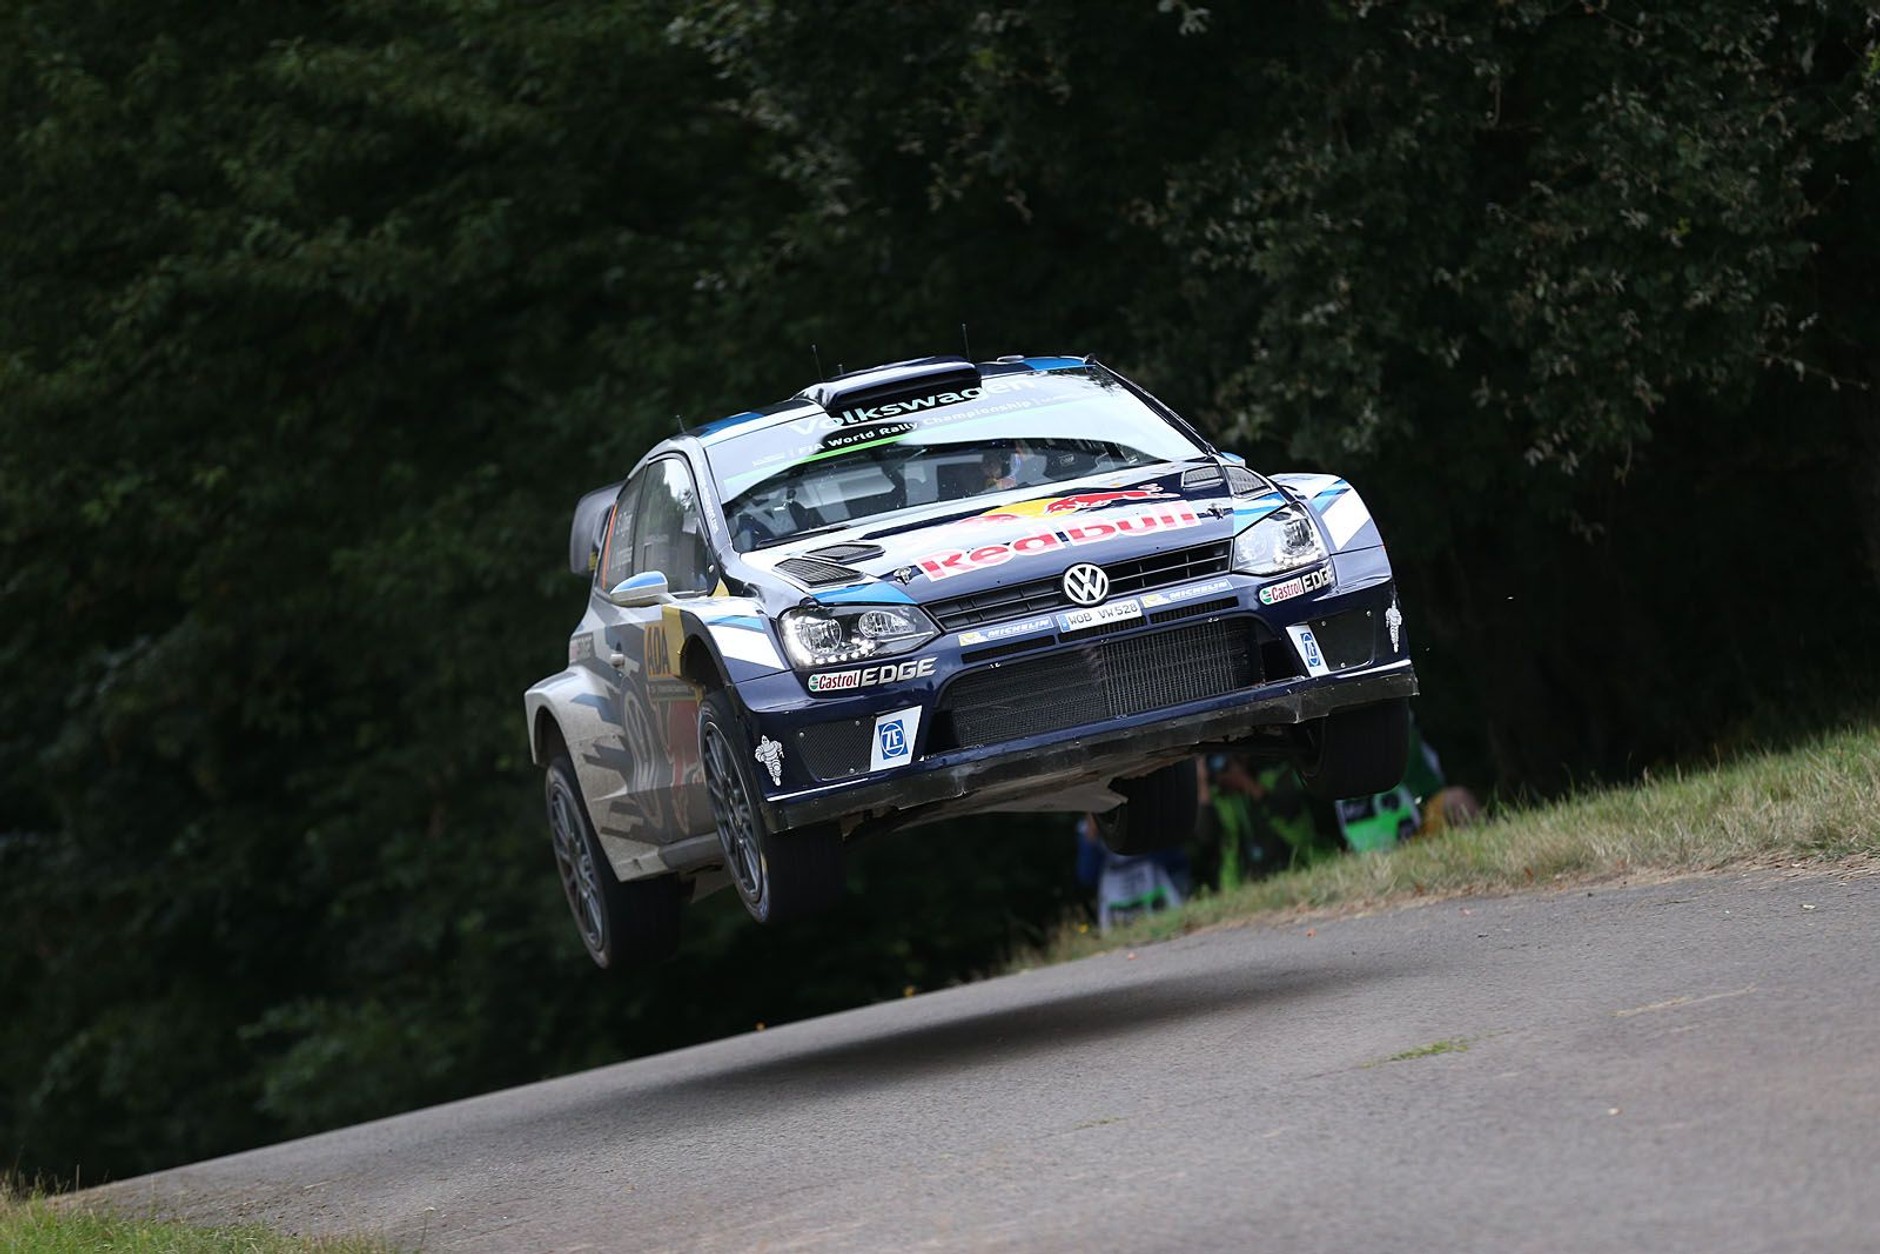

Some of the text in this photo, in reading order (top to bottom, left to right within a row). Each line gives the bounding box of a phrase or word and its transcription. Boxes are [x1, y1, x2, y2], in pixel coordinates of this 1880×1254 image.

[790, 379, 1035, 434] Volkswagen
[828, 427, 875, 447] World
[879, 421, 918, 435] Rally
[923, 400, 1031, 425] Championship
[918, 527, 1066, 580] Red
[1271, 581, 1302, 601] Castrol
[1068, 612, 1092, 625] WOB
[818, 657, 937, 690] Castrol EDGE
